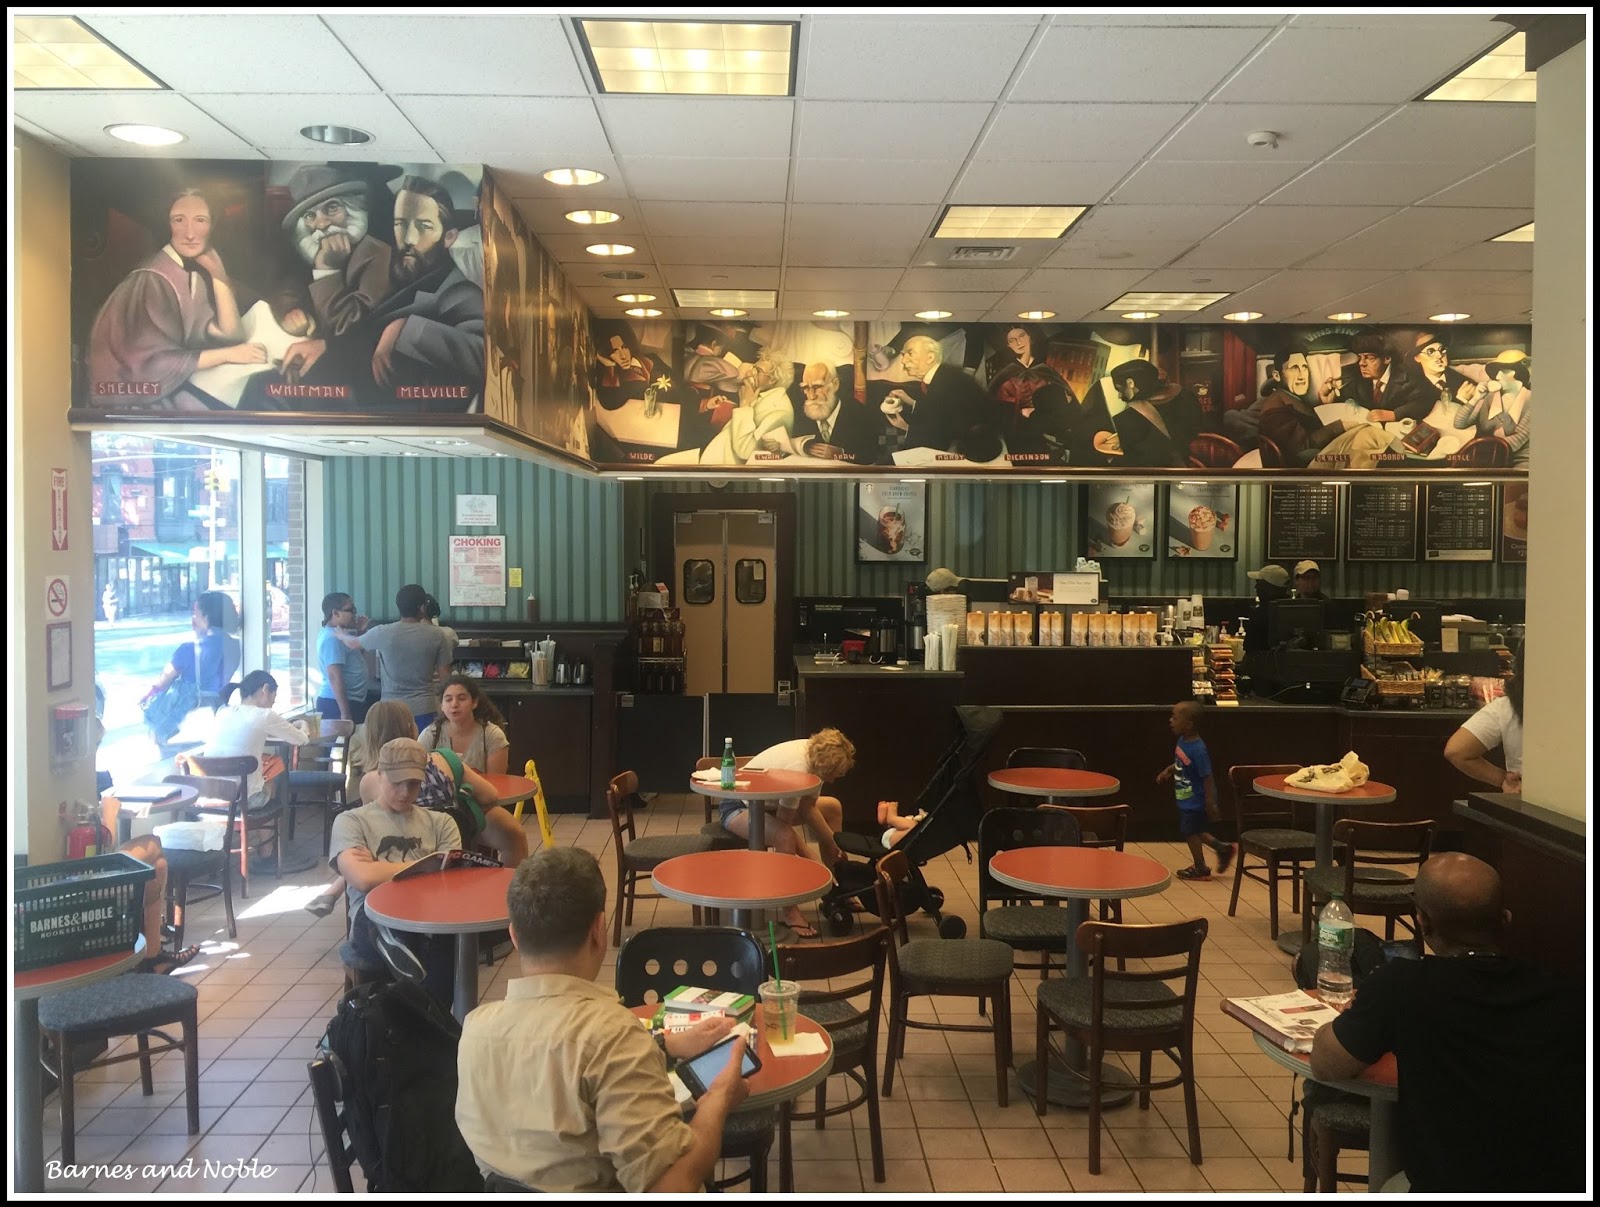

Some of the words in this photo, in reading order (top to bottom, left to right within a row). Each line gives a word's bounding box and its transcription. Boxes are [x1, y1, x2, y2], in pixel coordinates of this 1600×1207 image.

[98, 382, 160, 394] SHELLEY
[269, 384, 345, 398] WHITMAN
[400, 386, 468, 399] MELVILLE
[629, 452, 654, 461] WILDE
[1006, 453, 1050, 461] DICKINSON
[1316, 454, 1348, 462] ORWELL
[1371, 453, 1405, 461] NABOKOV
[453, 538, 501, 547] CHOKING
[40, 921, 105, 939] BOOKSELLERS
